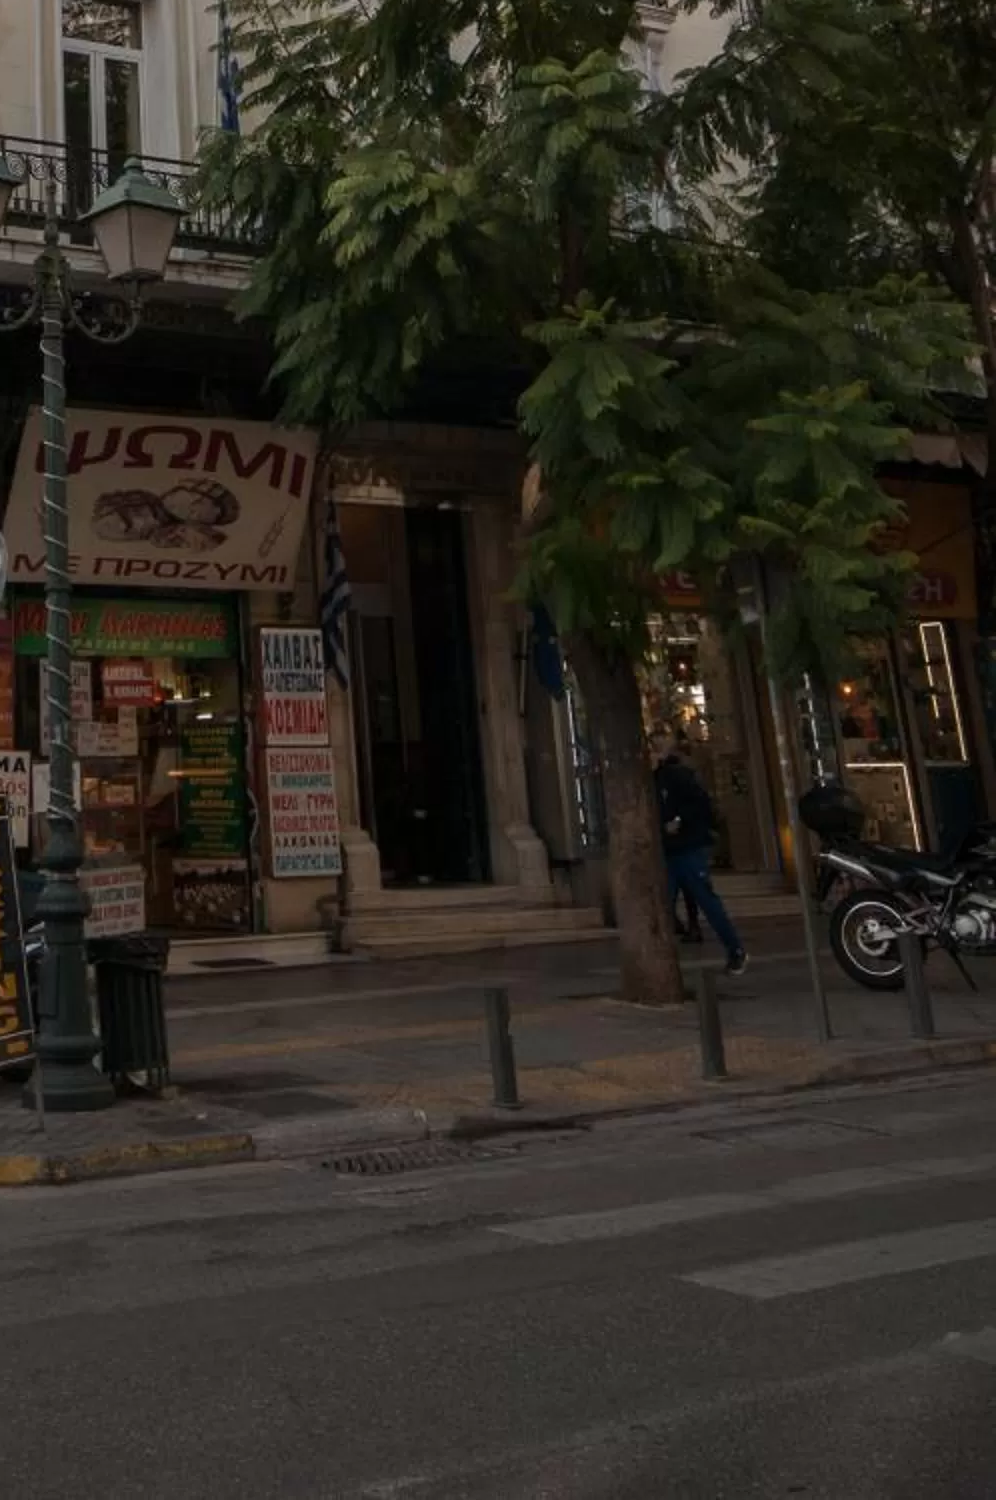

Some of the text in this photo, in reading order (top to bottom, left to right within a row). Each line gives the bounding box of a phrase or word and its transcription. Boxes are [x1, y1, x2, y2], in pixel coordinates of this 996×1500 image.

[35, 425, 307, 498] ΨΩΜΙ
[92, 557, 288, 583] ΠΡΟΖΥΜΙ
[263, 633, 322, 669] ΧΑΛΒΑΣ
[265, 699, 325, 734] ΚΟΣΜΙΔΗ
